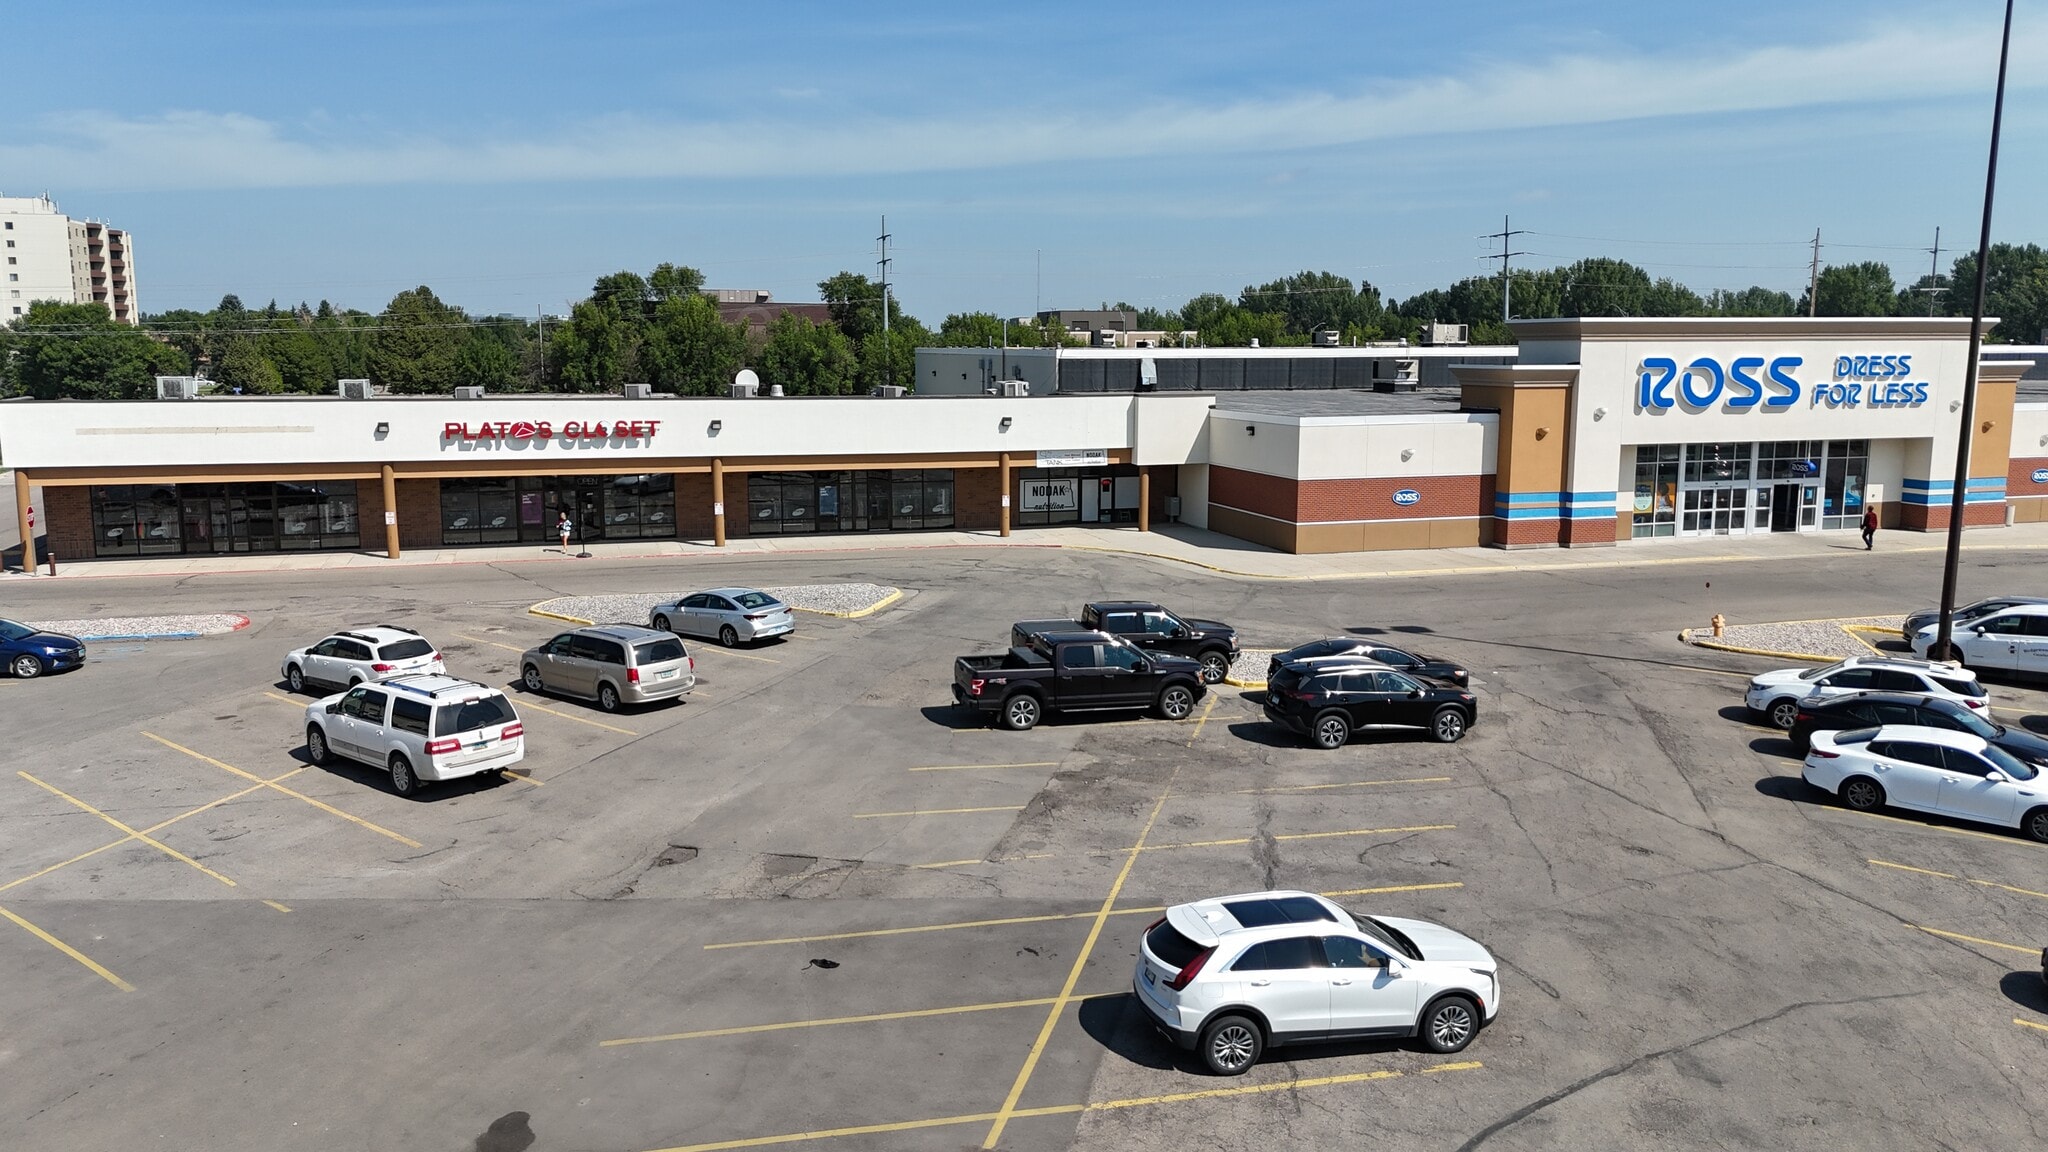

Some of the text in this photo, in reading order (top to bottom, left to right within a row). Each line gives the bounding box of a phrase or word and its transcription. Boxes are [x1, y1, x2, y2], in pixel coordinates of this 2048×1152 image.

[1836, 355, 1912, 377] DRESS
[1640, 357, 1803, 408] ROSS
[1814, 382, 1929, 405] FOR LESS
[1032, 485, 1066, 497] NODAK
[1396, 493, 1417, 501] ROSS
